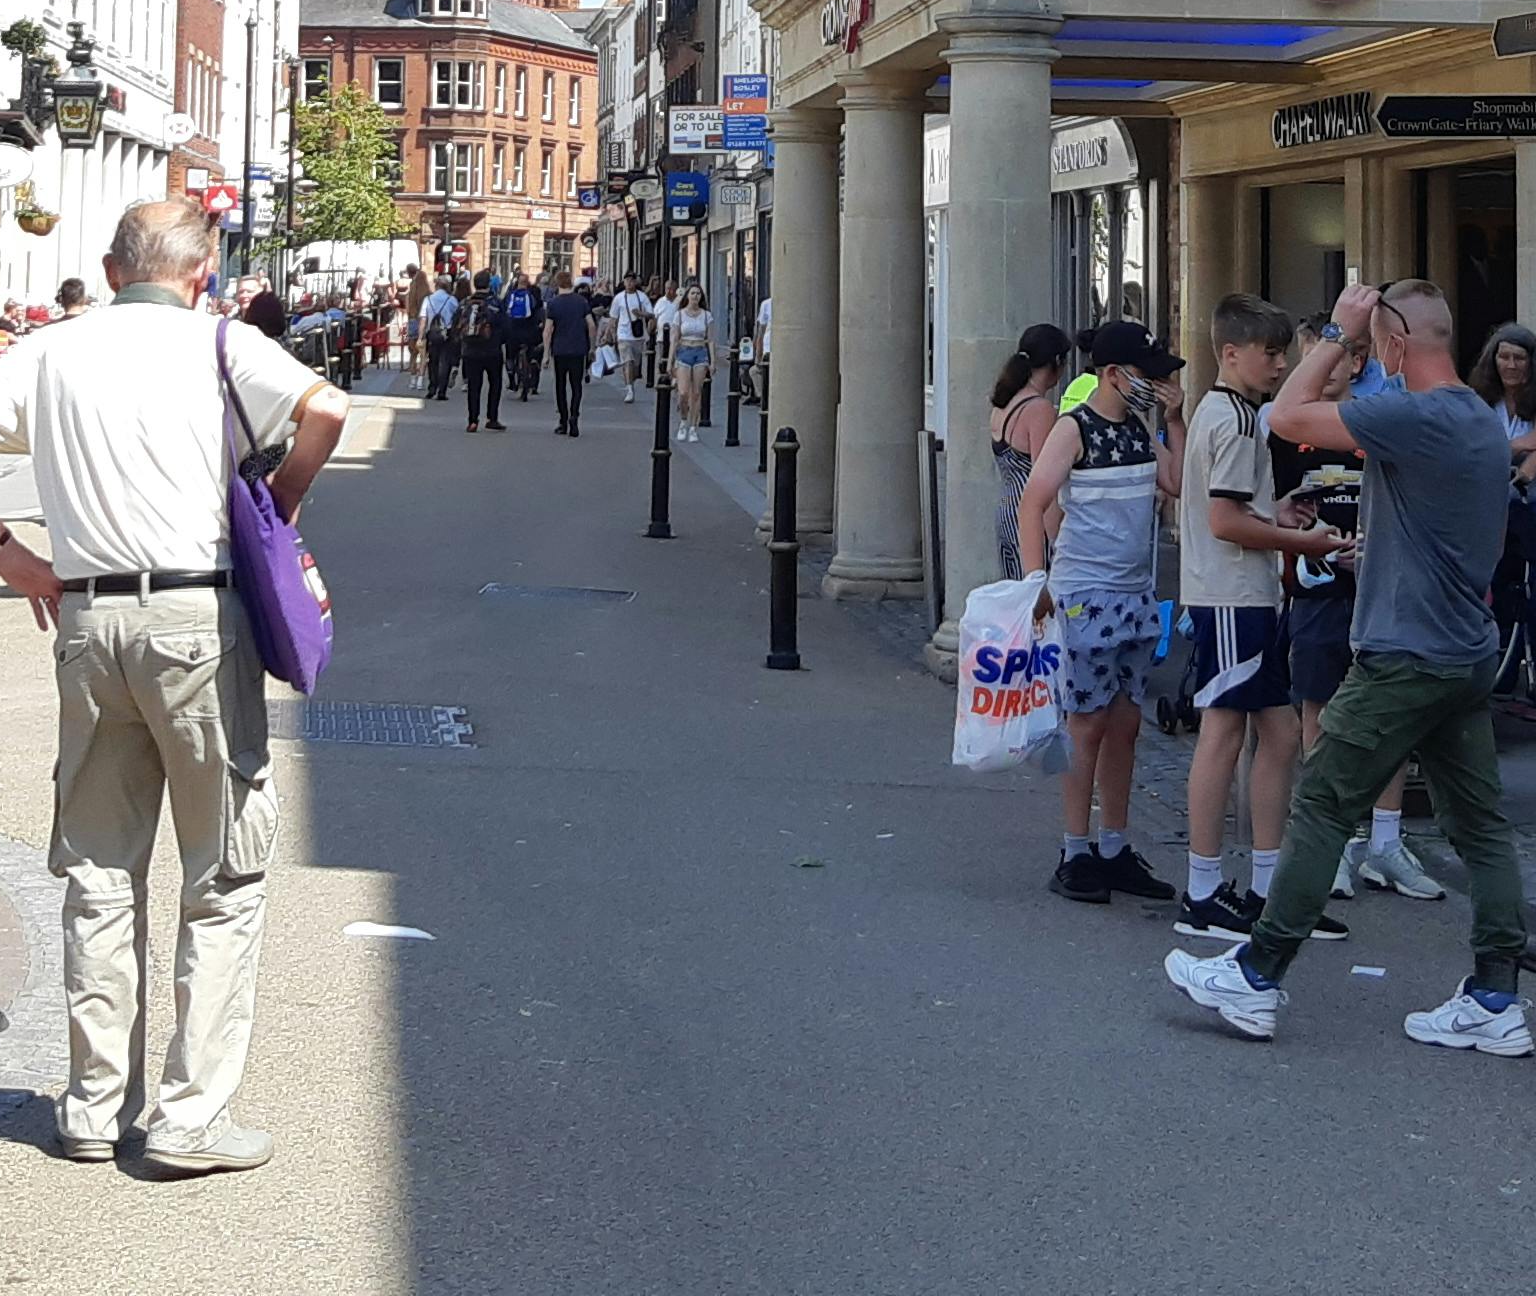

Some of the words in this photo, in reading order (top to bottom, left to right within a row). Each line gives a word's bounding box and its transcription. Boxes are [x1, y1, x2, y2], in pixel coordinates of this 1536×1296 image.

[726, 102, 745, 111] LET
[675, 113, 695, 122] FOR
[698, 113, 723, 121] SALE
[1271, 106, 1321, 148] CHAPEL
[1321, 92, 1371, 138] WALK
[1387, 117, 1503, 133] CrownGate-Friary
[673, 123, 688, 131] OR
[692, 123, 704, 131] TO
[707, 123, 724, 132] LET
[1052, 136, 1108, 174] STANFORDS
[971, 679, 1053, 718] DIREC
